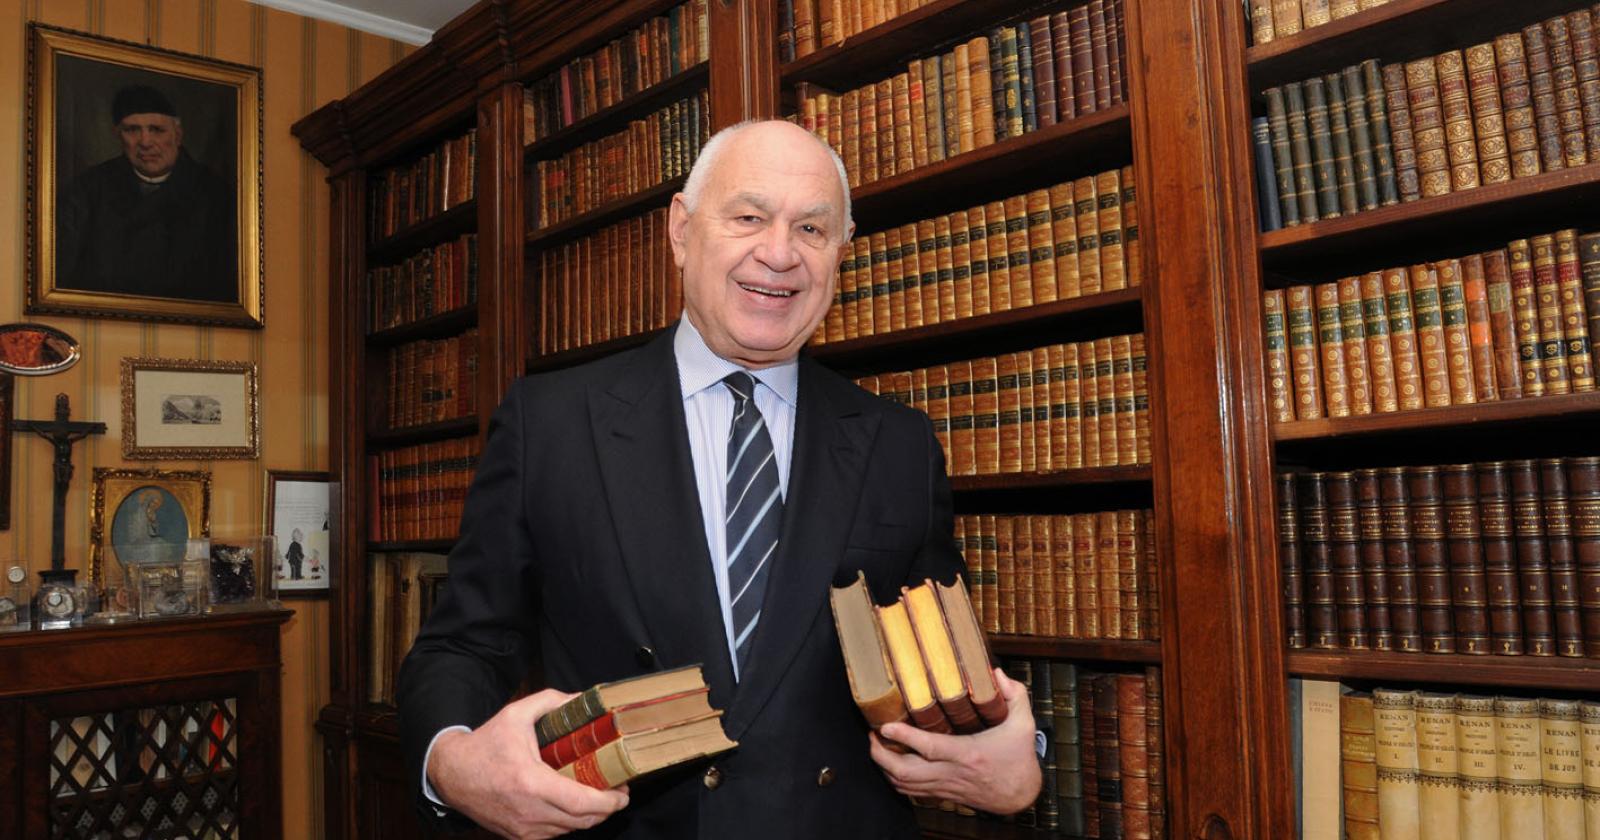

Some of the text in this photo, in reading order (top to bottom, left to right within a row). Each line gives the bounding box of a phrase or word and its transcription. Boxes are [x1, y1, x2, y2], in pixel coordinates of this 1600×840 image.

[1459, 720, 1490, 728] RENAN
[1546, 729, 1576, 737] RENAN
[1544, 747, 1553, 755] LE
[1556, 749, 1580, 757] LIVRE
[1549, 763, 1559, 771] DE
